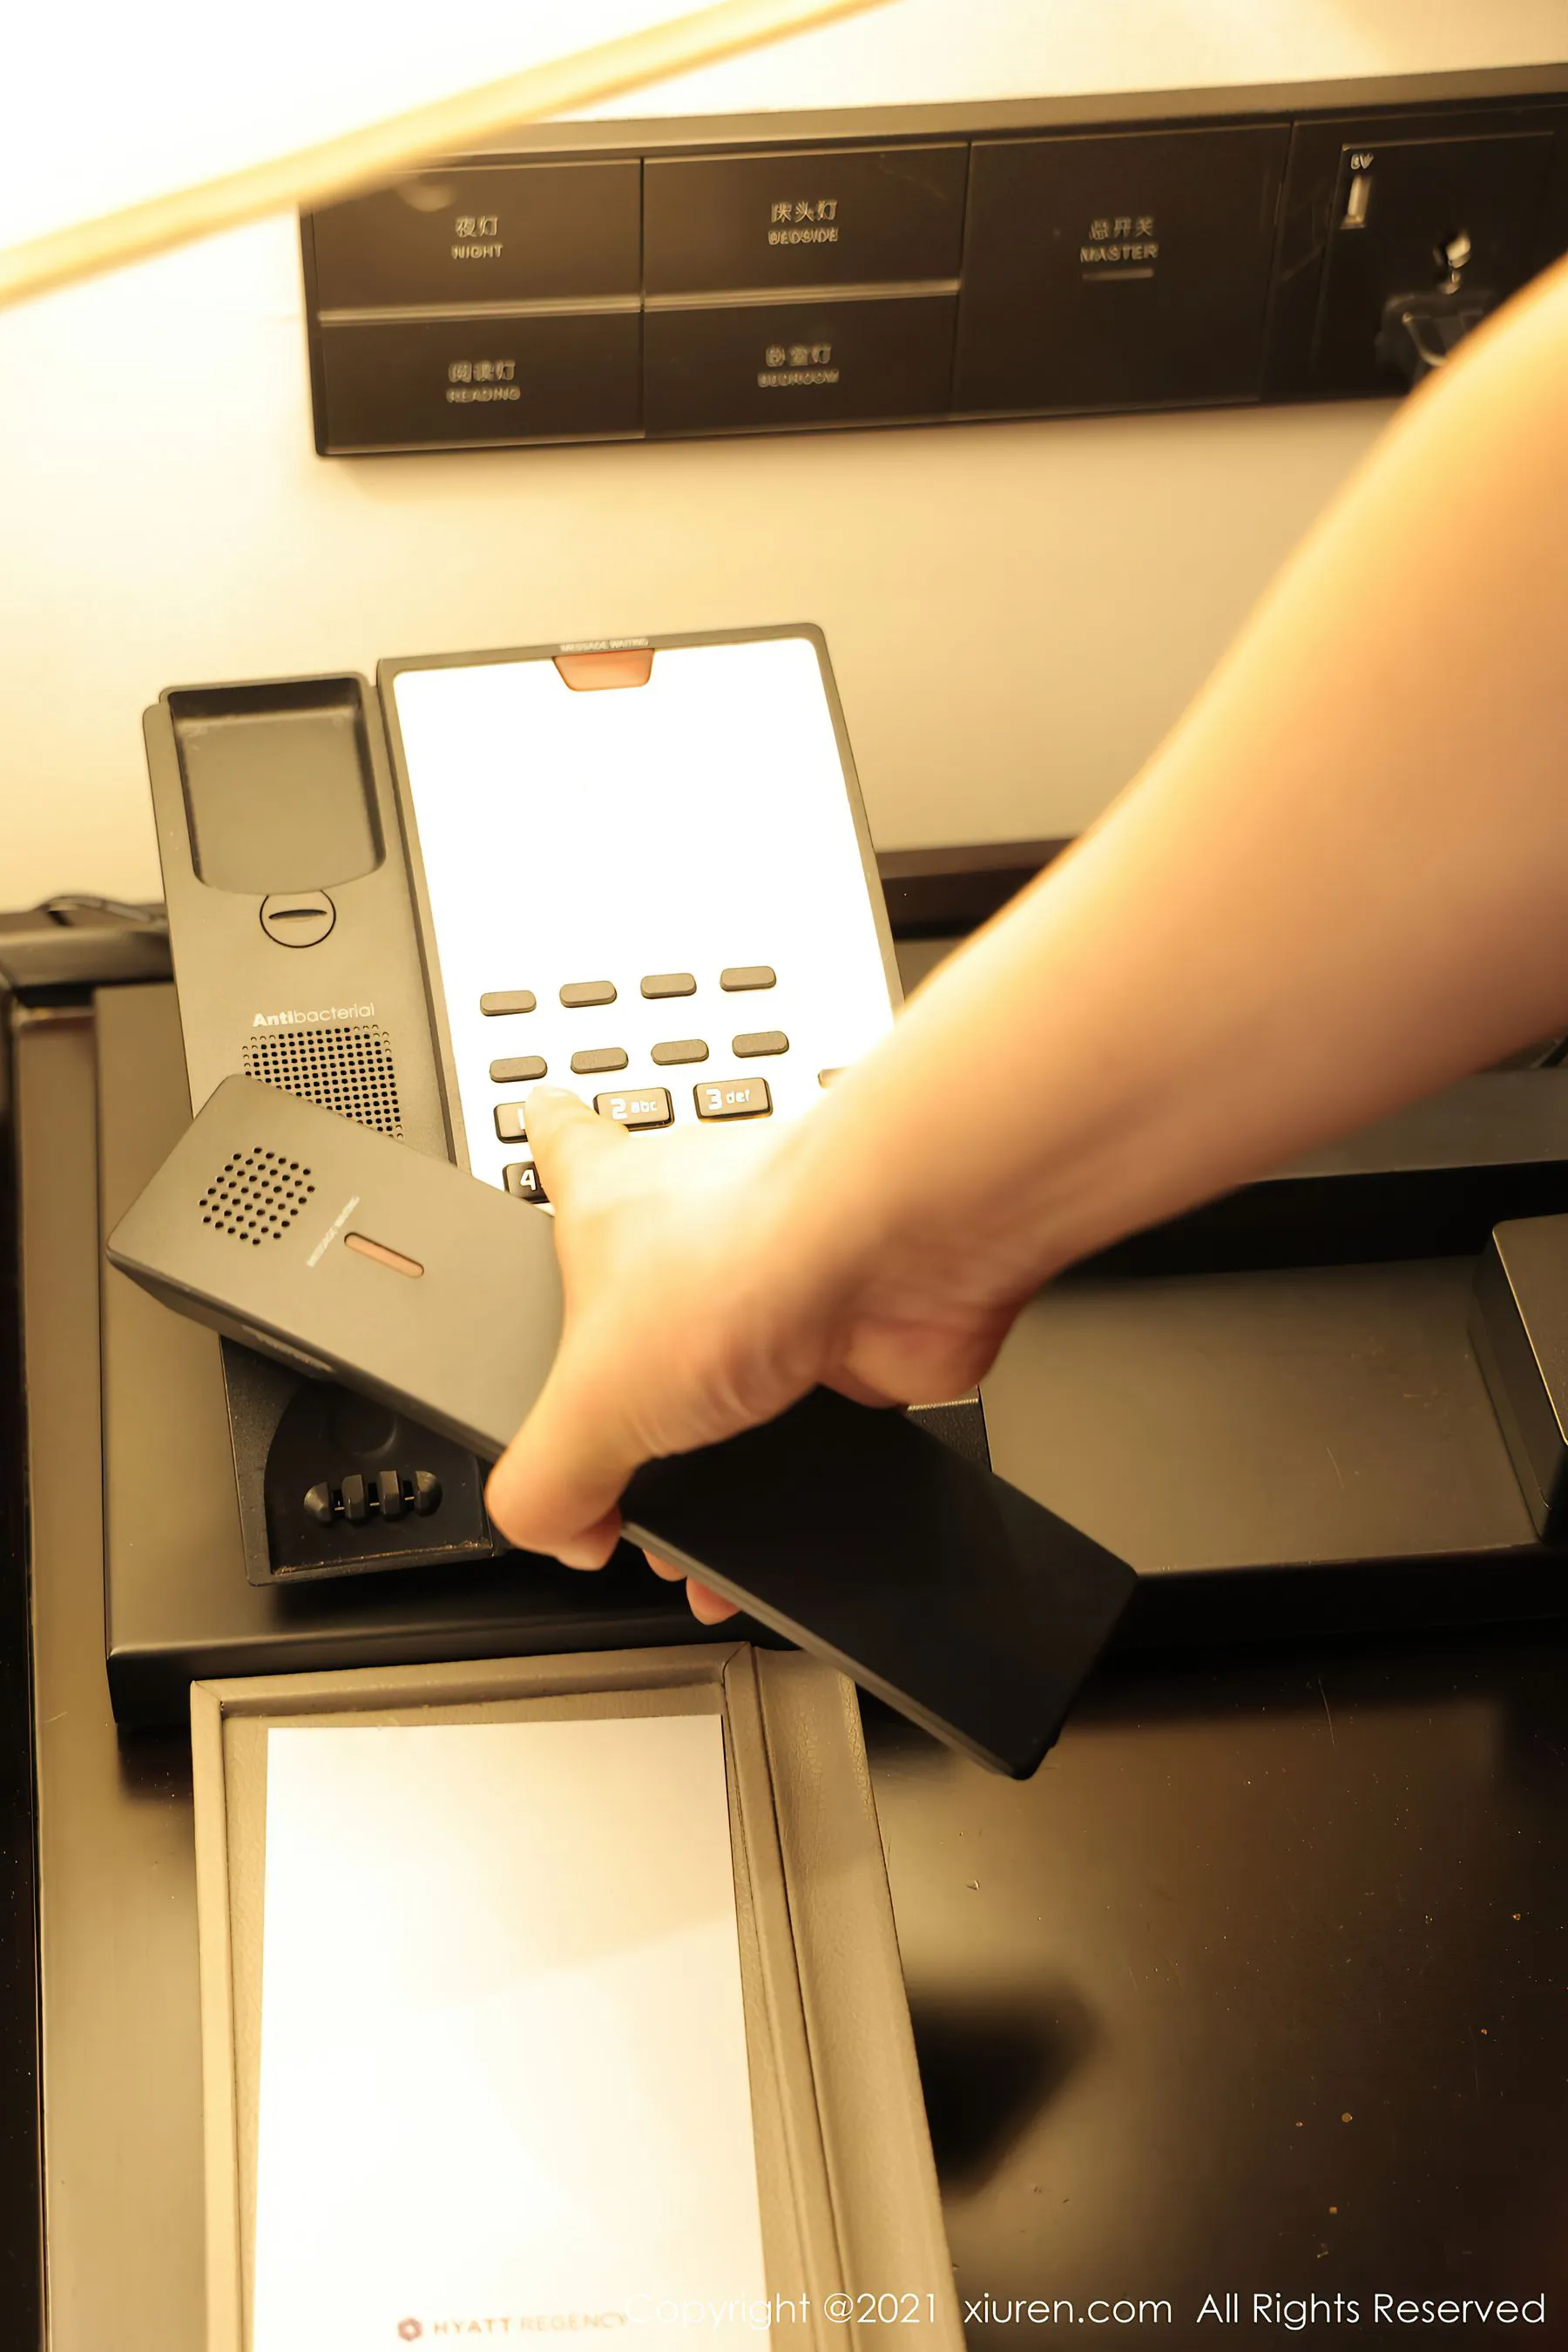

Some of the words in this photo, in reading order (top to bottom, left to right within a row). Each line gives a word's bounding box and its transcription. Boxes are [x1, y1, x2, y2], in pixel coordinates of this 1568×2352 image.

[456, 216, 498, 238] 夜灯
[767, 227, 839, 245] BEDSIDE
[451, 244, 504, 259] NIGHT
[1080, 243, 1159, 262] MASTER
[757, 369, 840, 388] BEDROOM
[446, 386, 521, 403] READING
[252, 1002, 375, 1027] Antibacterial
[611, 1098, 628, 1120] 2
[630, 1099, 659, 1114] abc
[706, 1088, 723, 1111] 3
[726, 1089, 751, 1104] def
[520, 1168, 537, 1192] 4
[434, 2317, 512, 2335] HYATT
[520, 2311, 628, 2332] REGENCY
